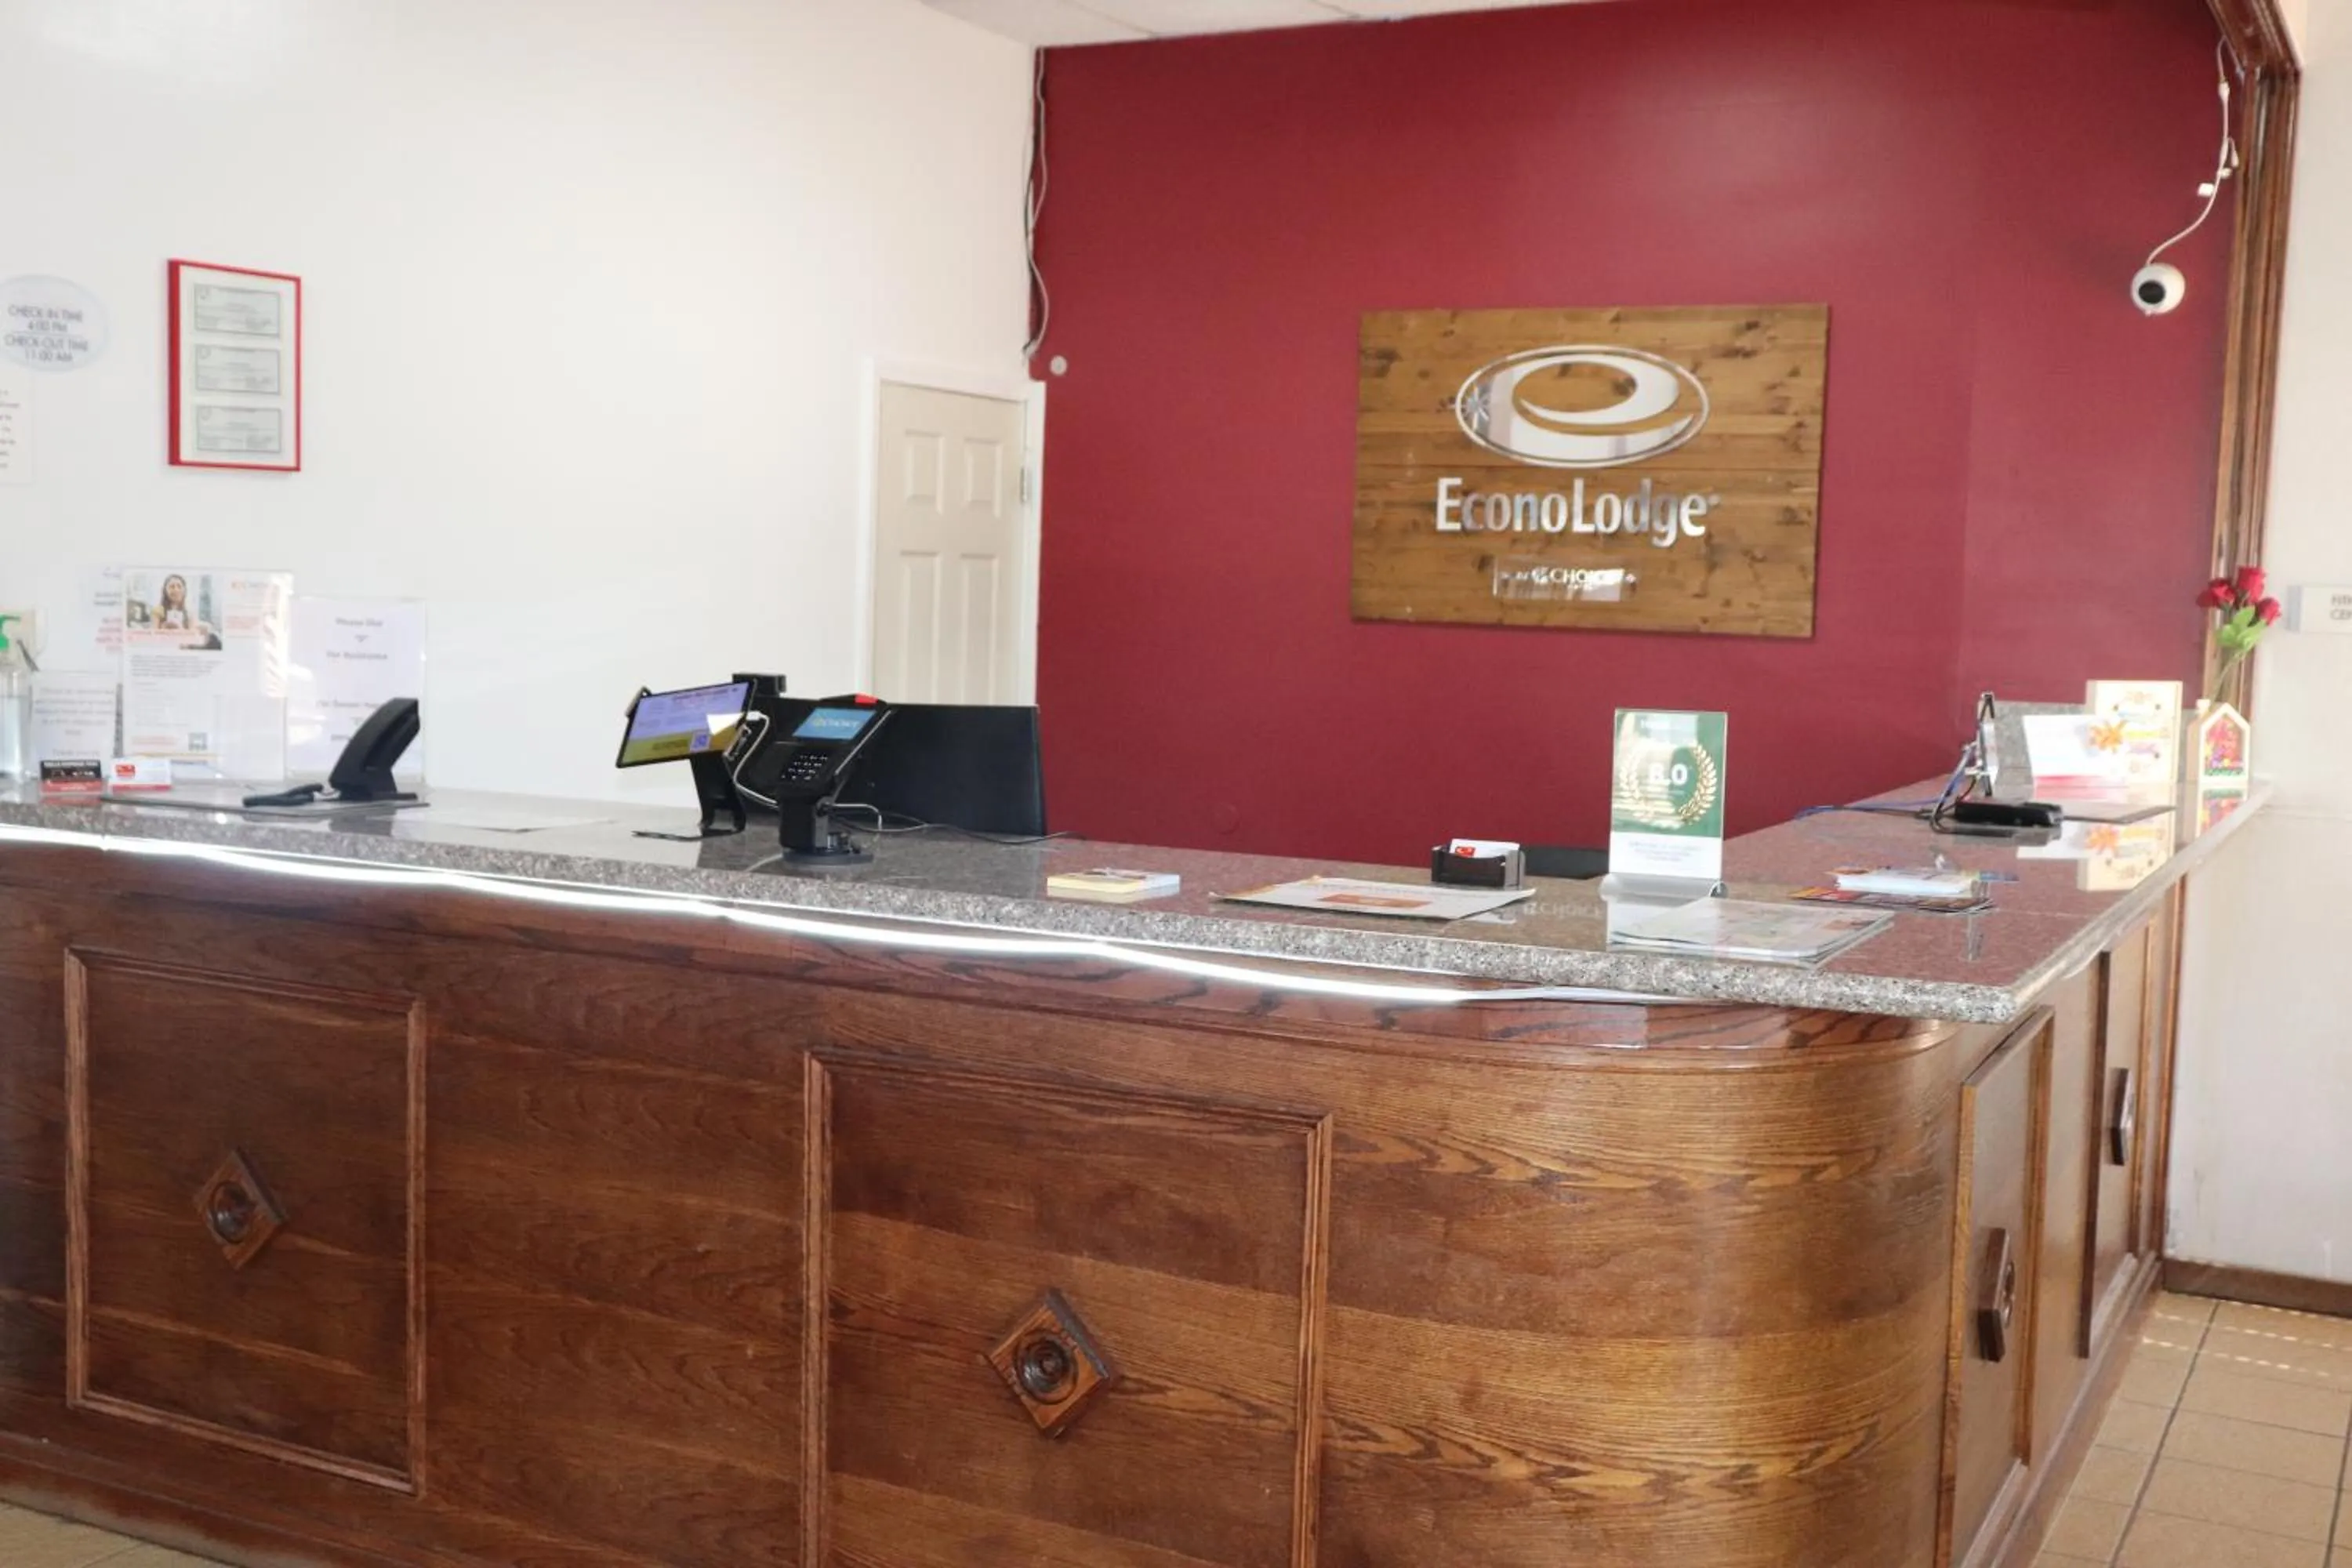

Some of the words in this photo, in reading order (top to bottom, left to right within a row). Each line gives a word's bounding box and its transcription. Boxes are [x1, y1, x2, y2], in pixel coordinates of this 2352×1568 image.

[8, 303, 42, 318] CHECK
[4, 333, 38, 347] CHECK
[1436, 477, 1708, 548] EconoLodge
